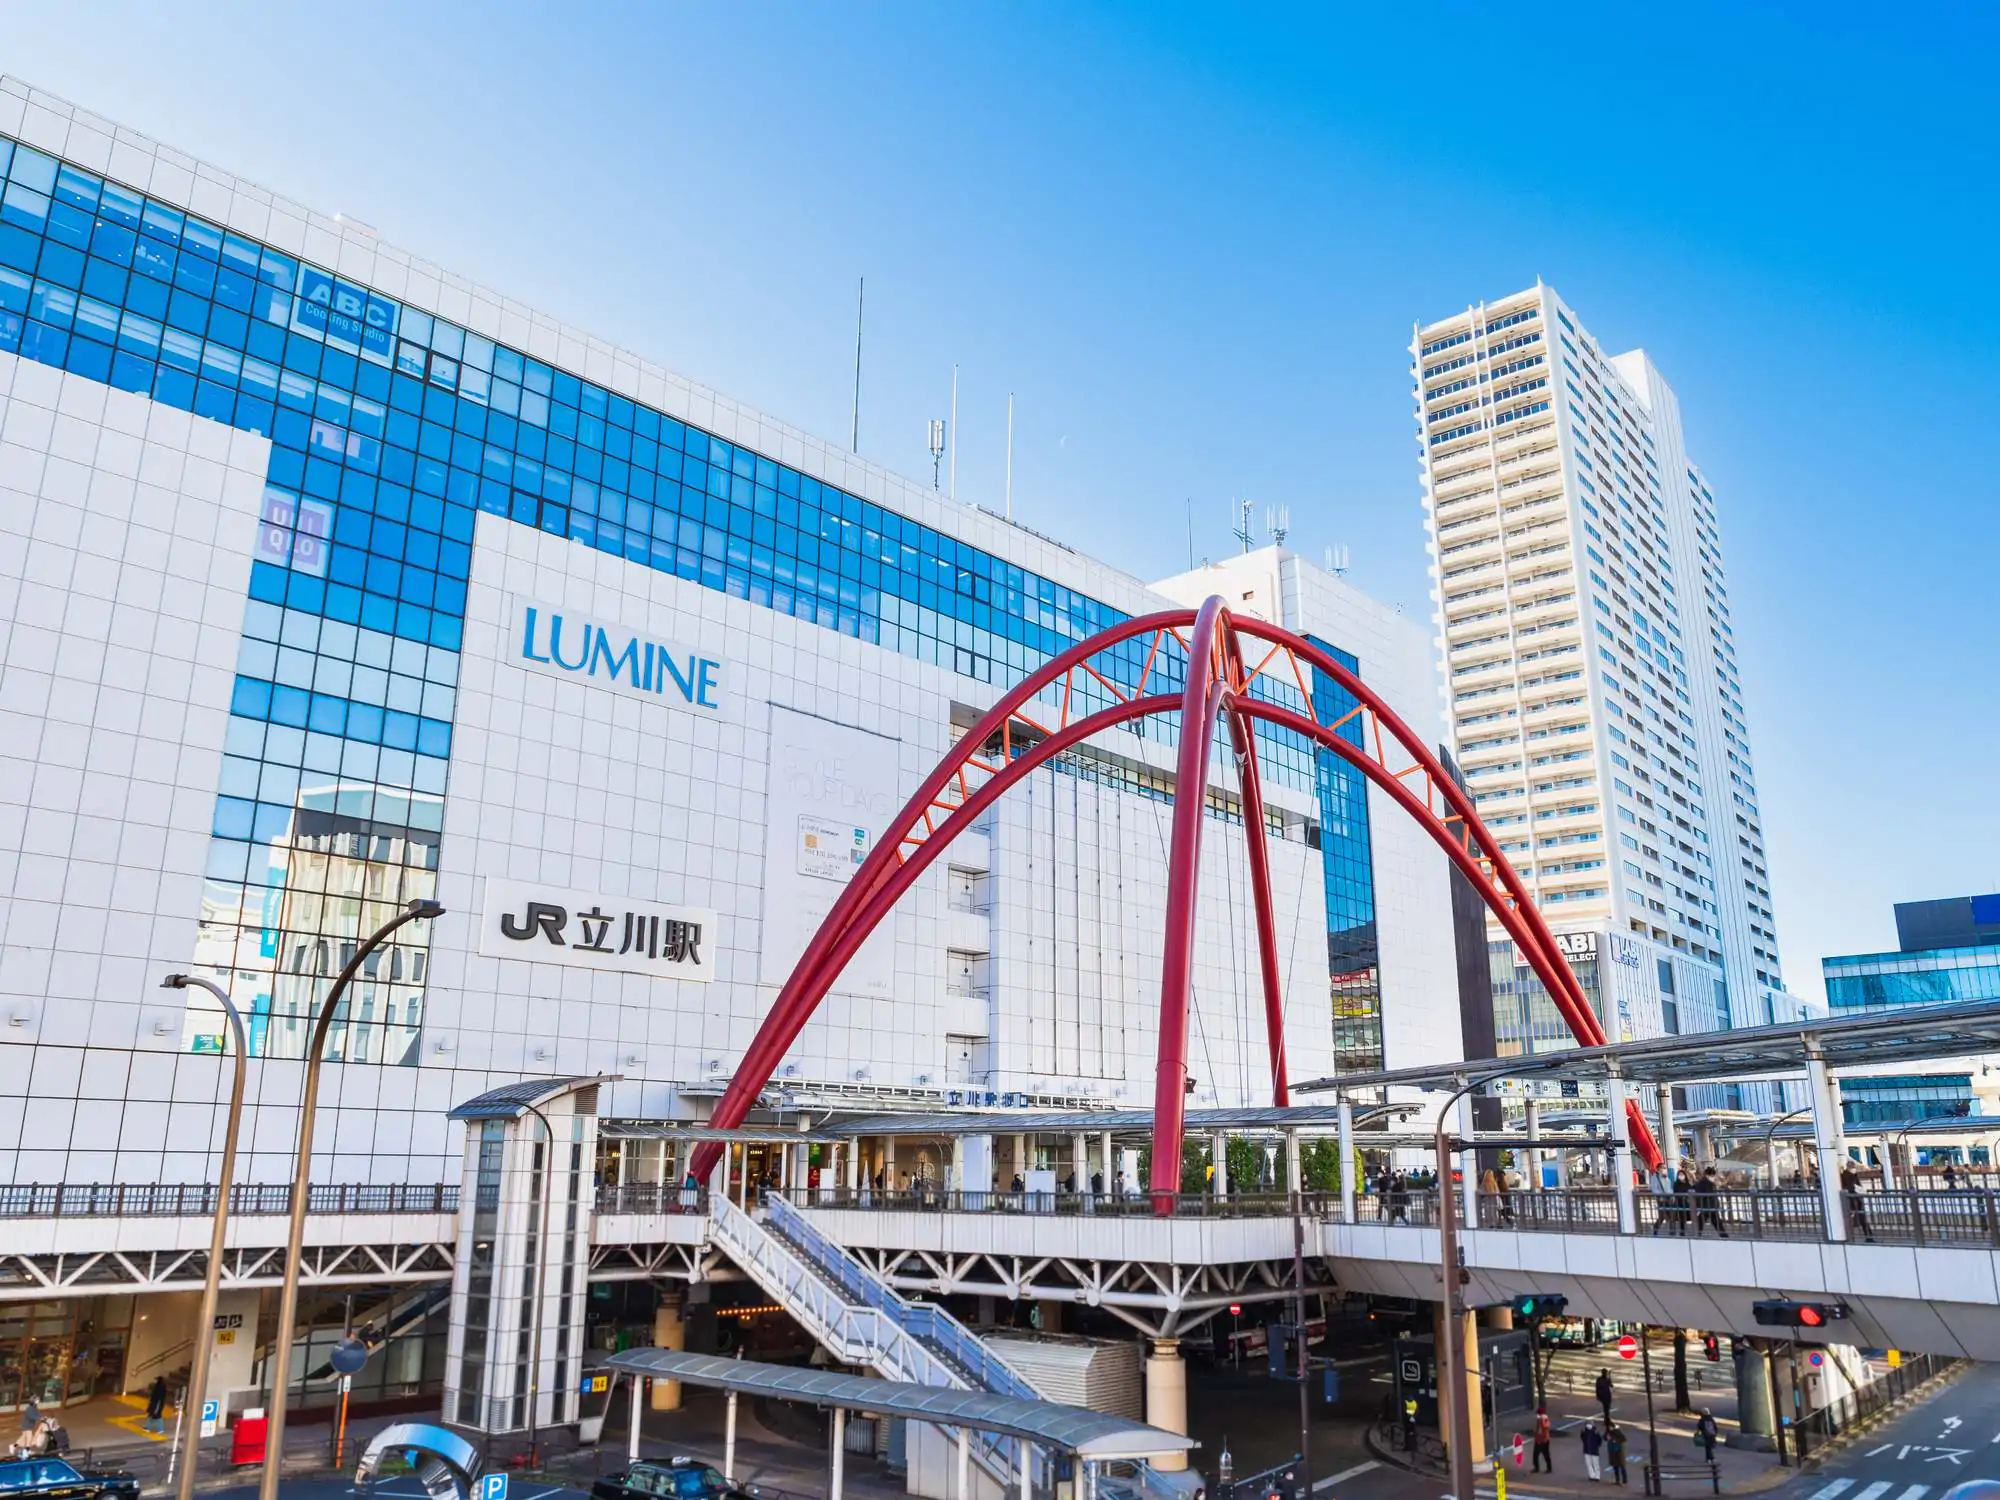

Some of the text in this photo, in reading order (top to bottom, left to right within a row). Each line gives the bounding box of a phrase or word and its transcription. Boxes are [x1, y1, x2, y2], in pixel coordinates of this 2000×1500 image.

[309, 283, 387, 327] ABC
[523, 606, 720, 709] LUMINE
[1555, 932, 1597, 954] ABI
[202, 1403, 214, 1420] P
[1865, 1443, 1973, 1465] バス
[489, 1478, 502, 1498] P
